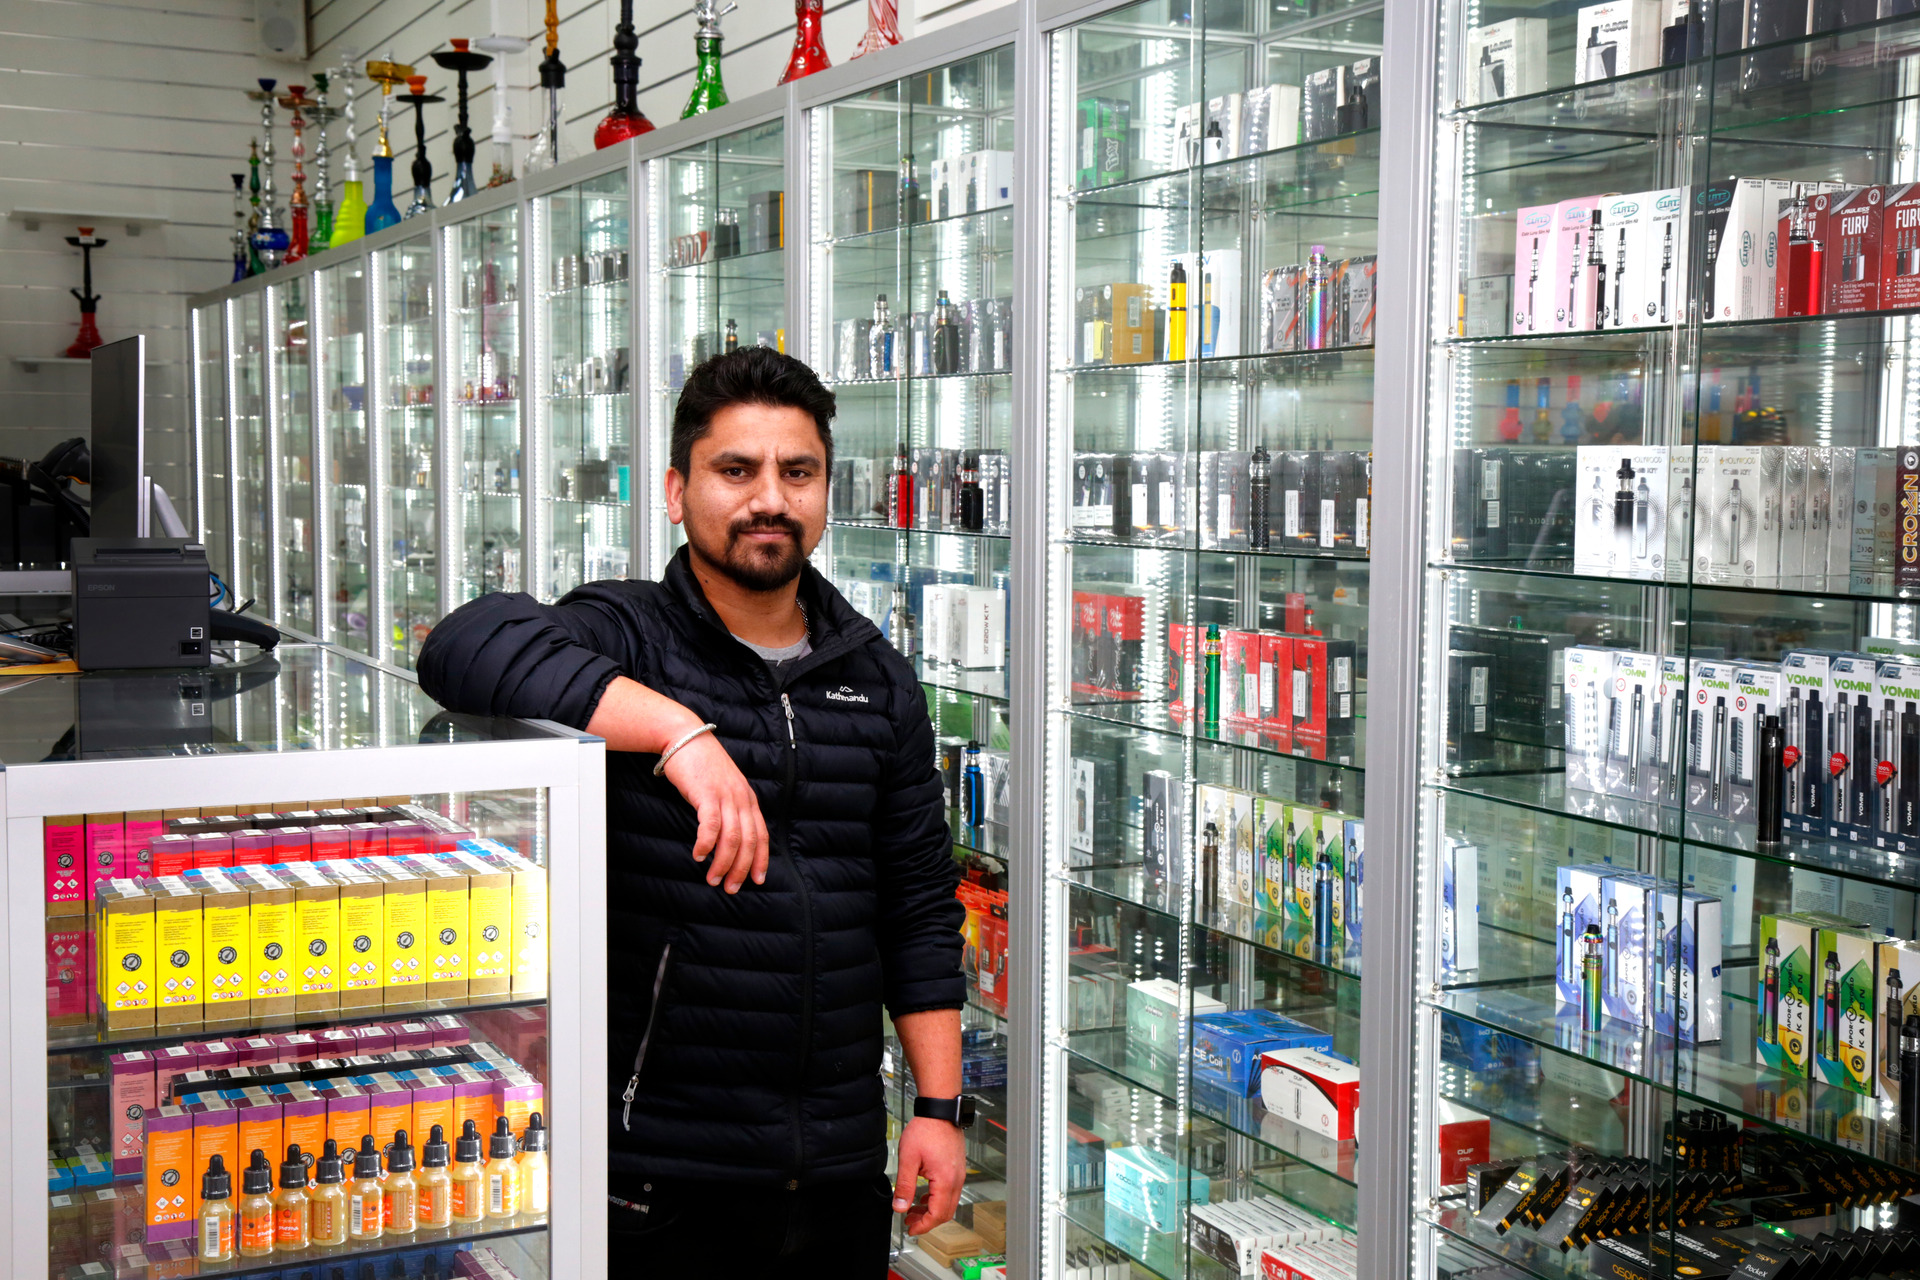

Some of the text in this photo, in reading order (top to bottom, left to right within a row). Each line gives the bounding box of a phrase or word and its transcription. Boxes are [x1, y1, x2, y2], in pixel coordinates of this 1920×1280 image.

[1895, 199, 1920, 208] LAWLES
[1841, 215, 1869, 236] FURY
[1663, 672, 1690, 683] VOMN
[1701, 678, 1730, 690] VOMNI
[1786, 673, 1823, 688] VOMNI
[1739, 685, 1770, 697] VOMNI
[1833, 678, 1872, 693] VOMNI
[826, 690, 869, 703] Kathmandu
[1880, 685, 1920, 700] VOMNI
[1209, 1054, 1223, 1068] Coil
